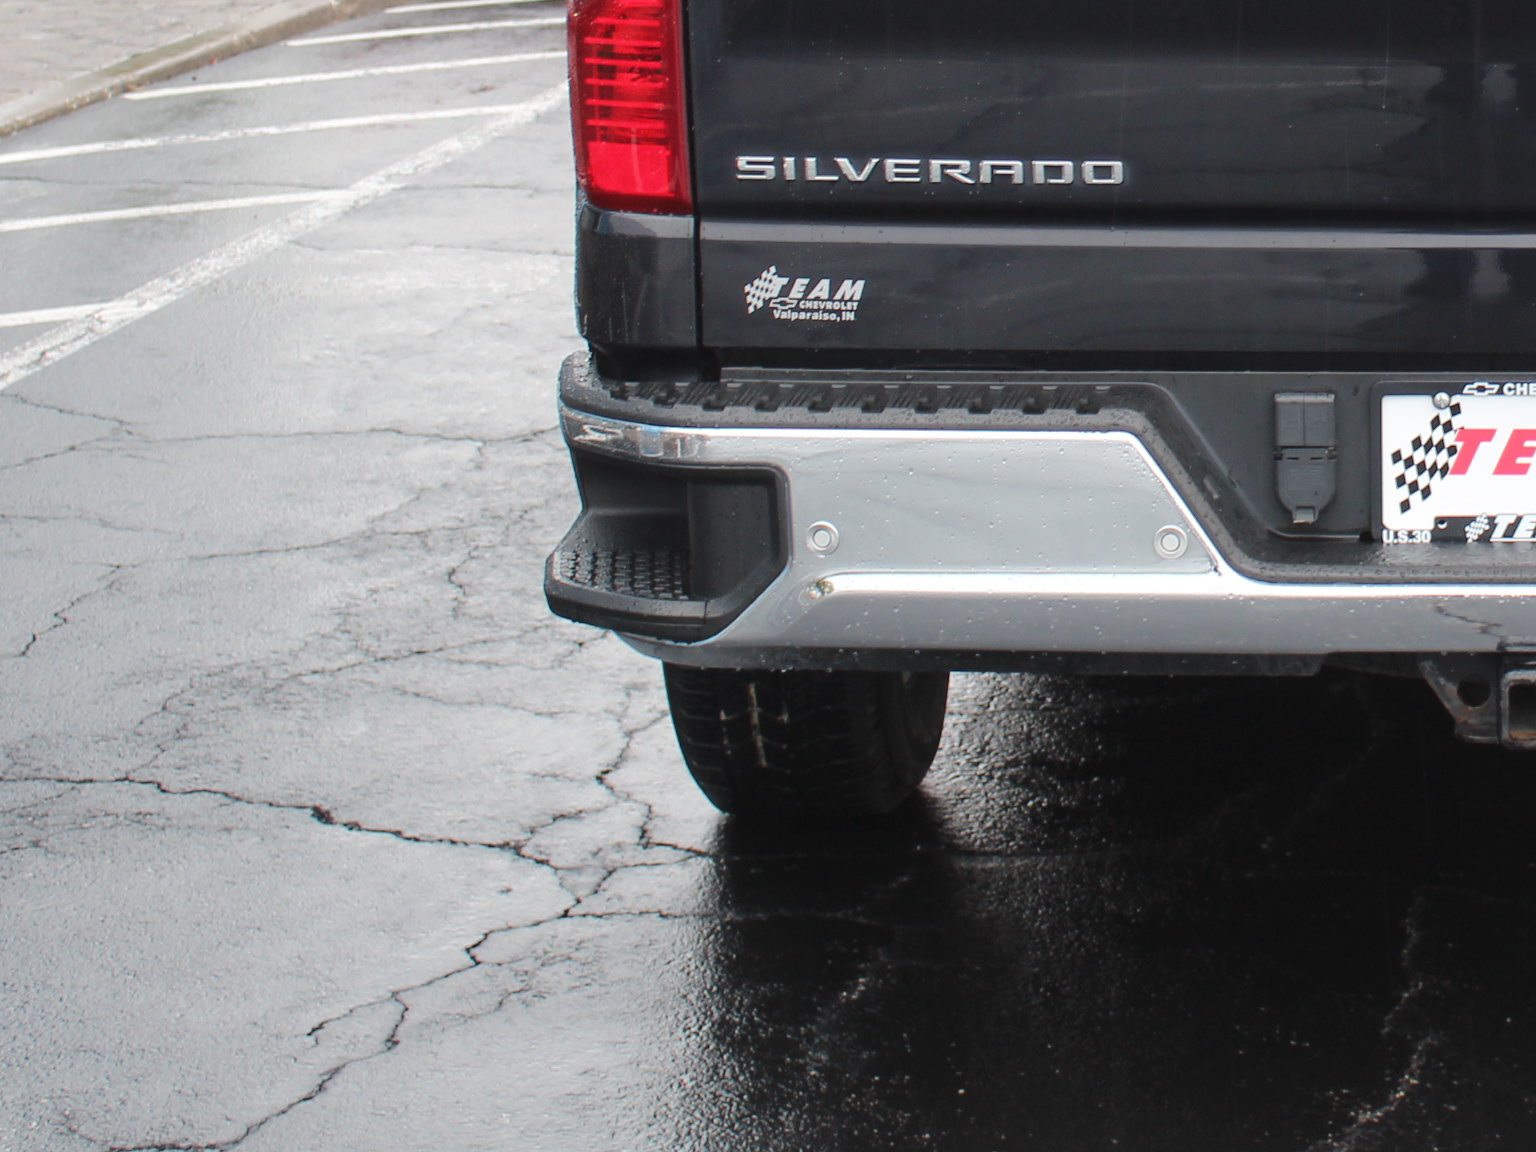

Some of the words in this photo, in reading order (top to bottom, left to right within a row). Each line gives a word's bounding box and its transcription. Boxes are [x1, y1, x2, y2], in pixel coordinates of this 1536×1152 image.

[734, 155, 1126, 186] SILVERADO
[765, 276, 866, 300] TEAM
[799, 300, 859, 311] CHEVROLET
